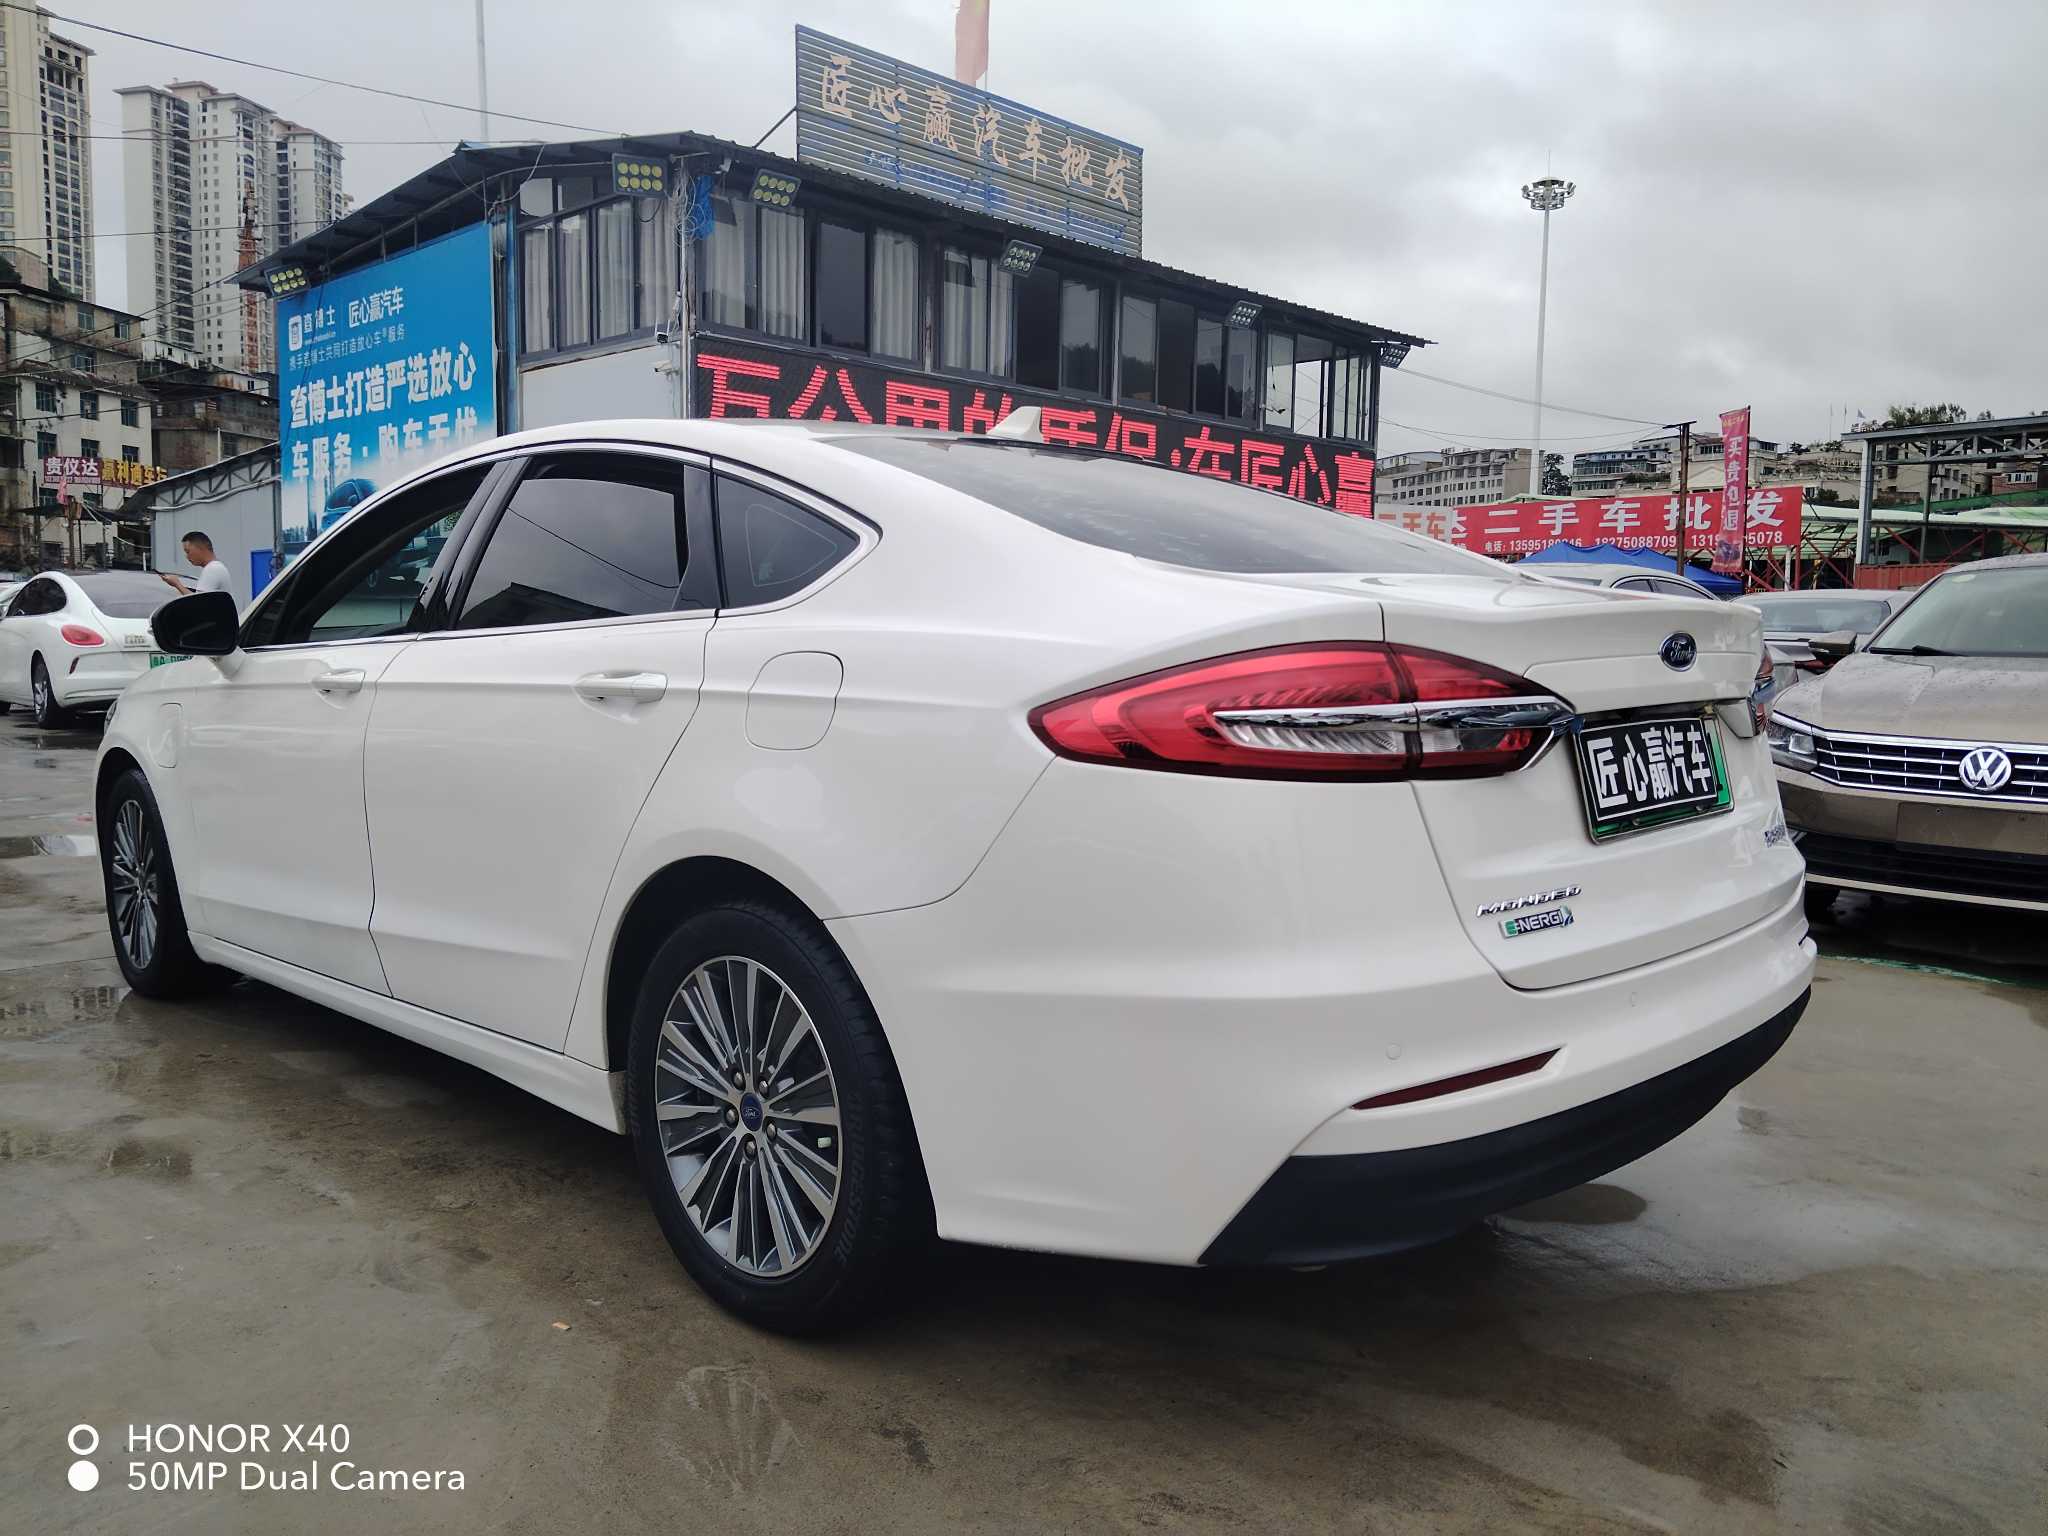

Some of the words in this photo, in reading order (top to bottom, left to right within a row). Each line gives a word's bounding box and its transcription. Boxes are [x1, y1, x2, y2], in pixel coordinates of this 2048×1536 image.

[820, 54, 1131, 211] 匠心赢汽车批发
[303, 305, 336, 333] 查博士
[348, 286, 404, 328] 匠心赢汽车
[290, 341, 477, 428] 查博士打造严选放心
[46, 457, 99, 476] 贵仪达
[1723, 435, 1743, 531] 买贵包退
[1587, 725, 1711, 809] 匠心赢汽车
